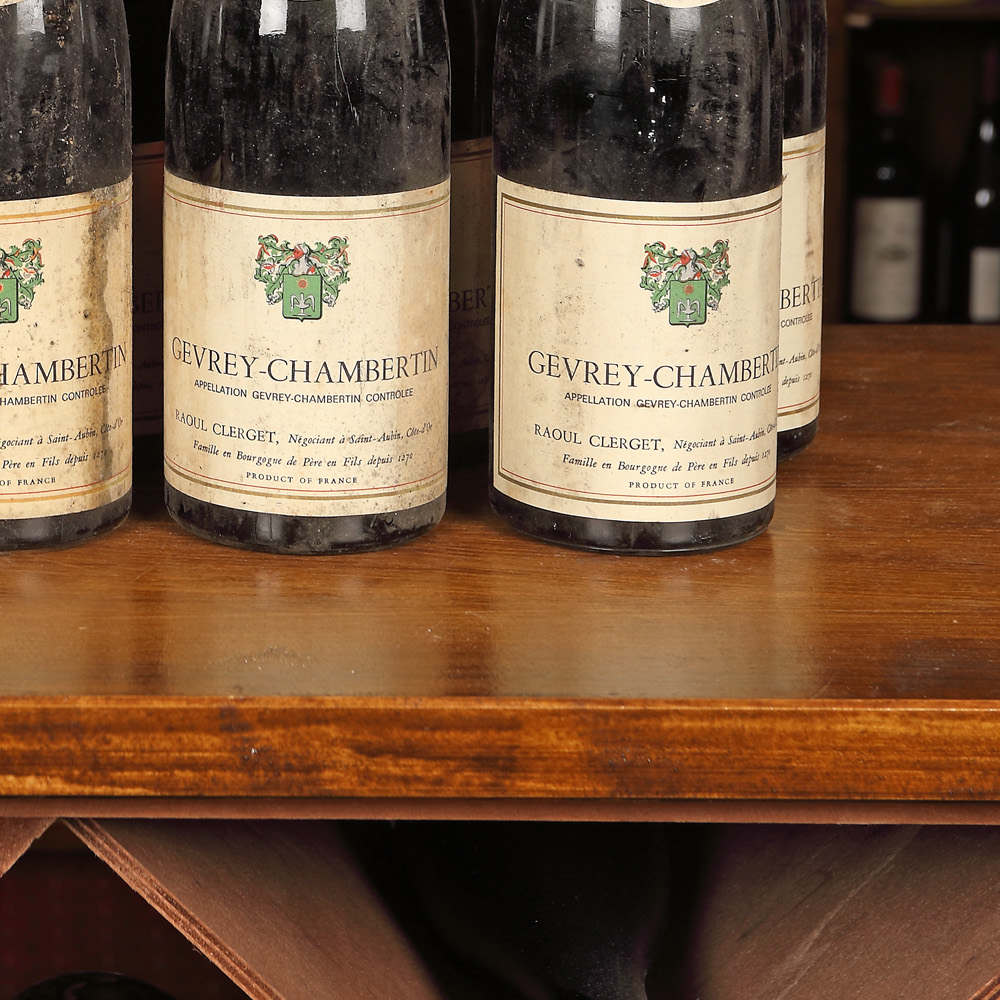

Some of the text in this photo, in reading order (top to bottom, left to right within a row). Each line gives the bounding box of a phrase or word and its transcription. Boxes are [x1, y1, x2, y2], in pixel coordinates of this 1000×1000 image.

[171, 336, 439, 384] GEVREY-CHAMBERTIN
[194, 379, 247, 397] APPELLATION
[252, 390, 361, 404] GEVREY-CHAMBERTIN
[564, 392, 631, 407] APPELLATION
[636, 395, 737, 409] GEVREY-CHAMBERTIN
[175, 408, 208, 432] RAOUL
[212, 423, 280, 445] CLERGET,
[288, 434, 336, 448] Négociant
[338, 434, 345, 444] à
[349, 430, 404, 445] Saint-Aubin,
[534, 423, 582, 445] RAOUL
[589, 434, 665, 453] CLERGET,
[673, 439, 717, 453] Négociant
[719, 436, 725, 446] à
[36, 435, 43, 445] à
[2, 459, 21, 469] Père
[42, 457, 60, 468] Fils
[64, 451, 89, 466] depuis
[193, 439, 220, 456] Famille
[222, 450, 232, 459] en
[236, 450, 282, 467] Bourgogne
[286, 455, 297, 466] de
[302, 457, 322, 467] Père
[343, 457, 362, 467] Fils
[367, 454, 393, 467] depuis
[562, 453, 597, 468] Famille
[601, 462, 612, 470] en
[618, 461, 668, 475] Bourgogne
[671, 461, 683, 472] de
[687, 461, 706, 472] Père
[723, 456, 738, 468] Fils
[741, 452, 760, 467] depuis
[0, 479, 12, 487] OF
[17, 476, 56, 486] FRANCE
[246, 471, 293, 483] PRODUCT
[318, 477, 358, 485] FRANCE
[628, 477, 735, 490] PRODUCT OF FRANCE
